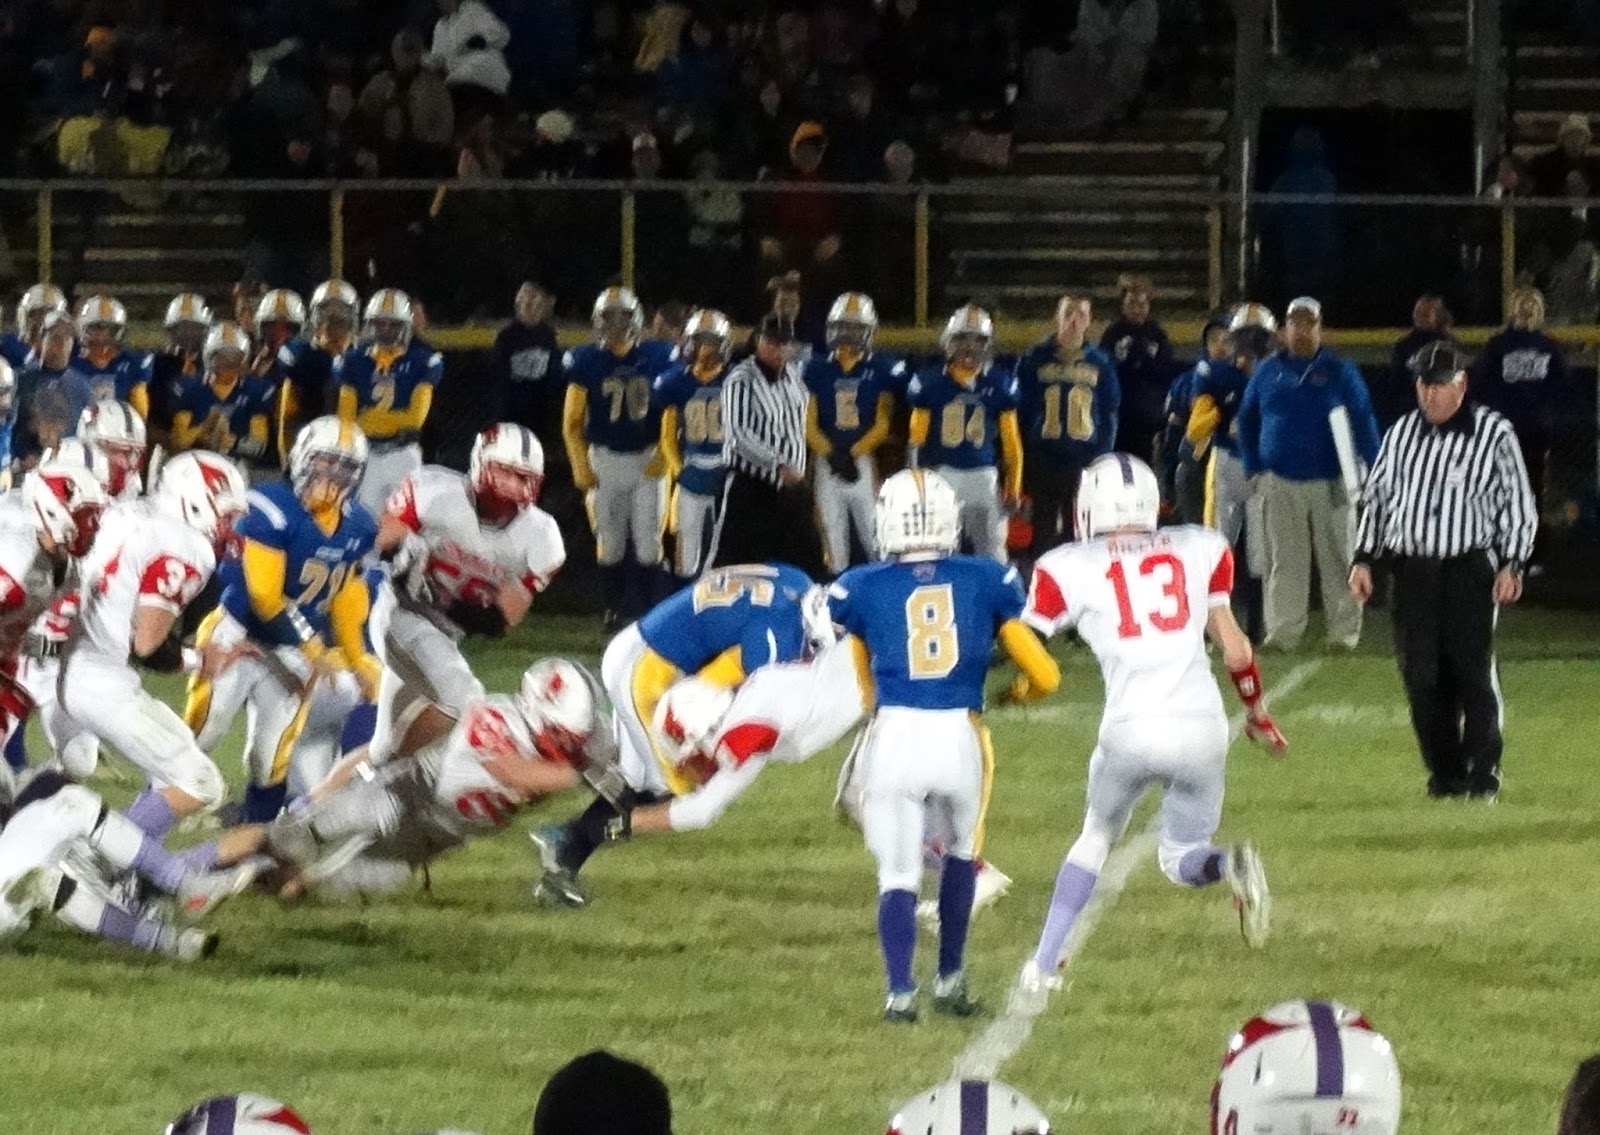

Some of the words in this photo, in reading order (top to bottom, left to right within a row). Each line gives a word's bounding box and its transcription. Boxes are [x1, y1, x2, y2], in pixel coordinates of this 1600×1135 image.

[1041, 383, 1095, 440] 10
[906, 583, 958, 680] 8
[1106, 554, 1190, 638] 13
